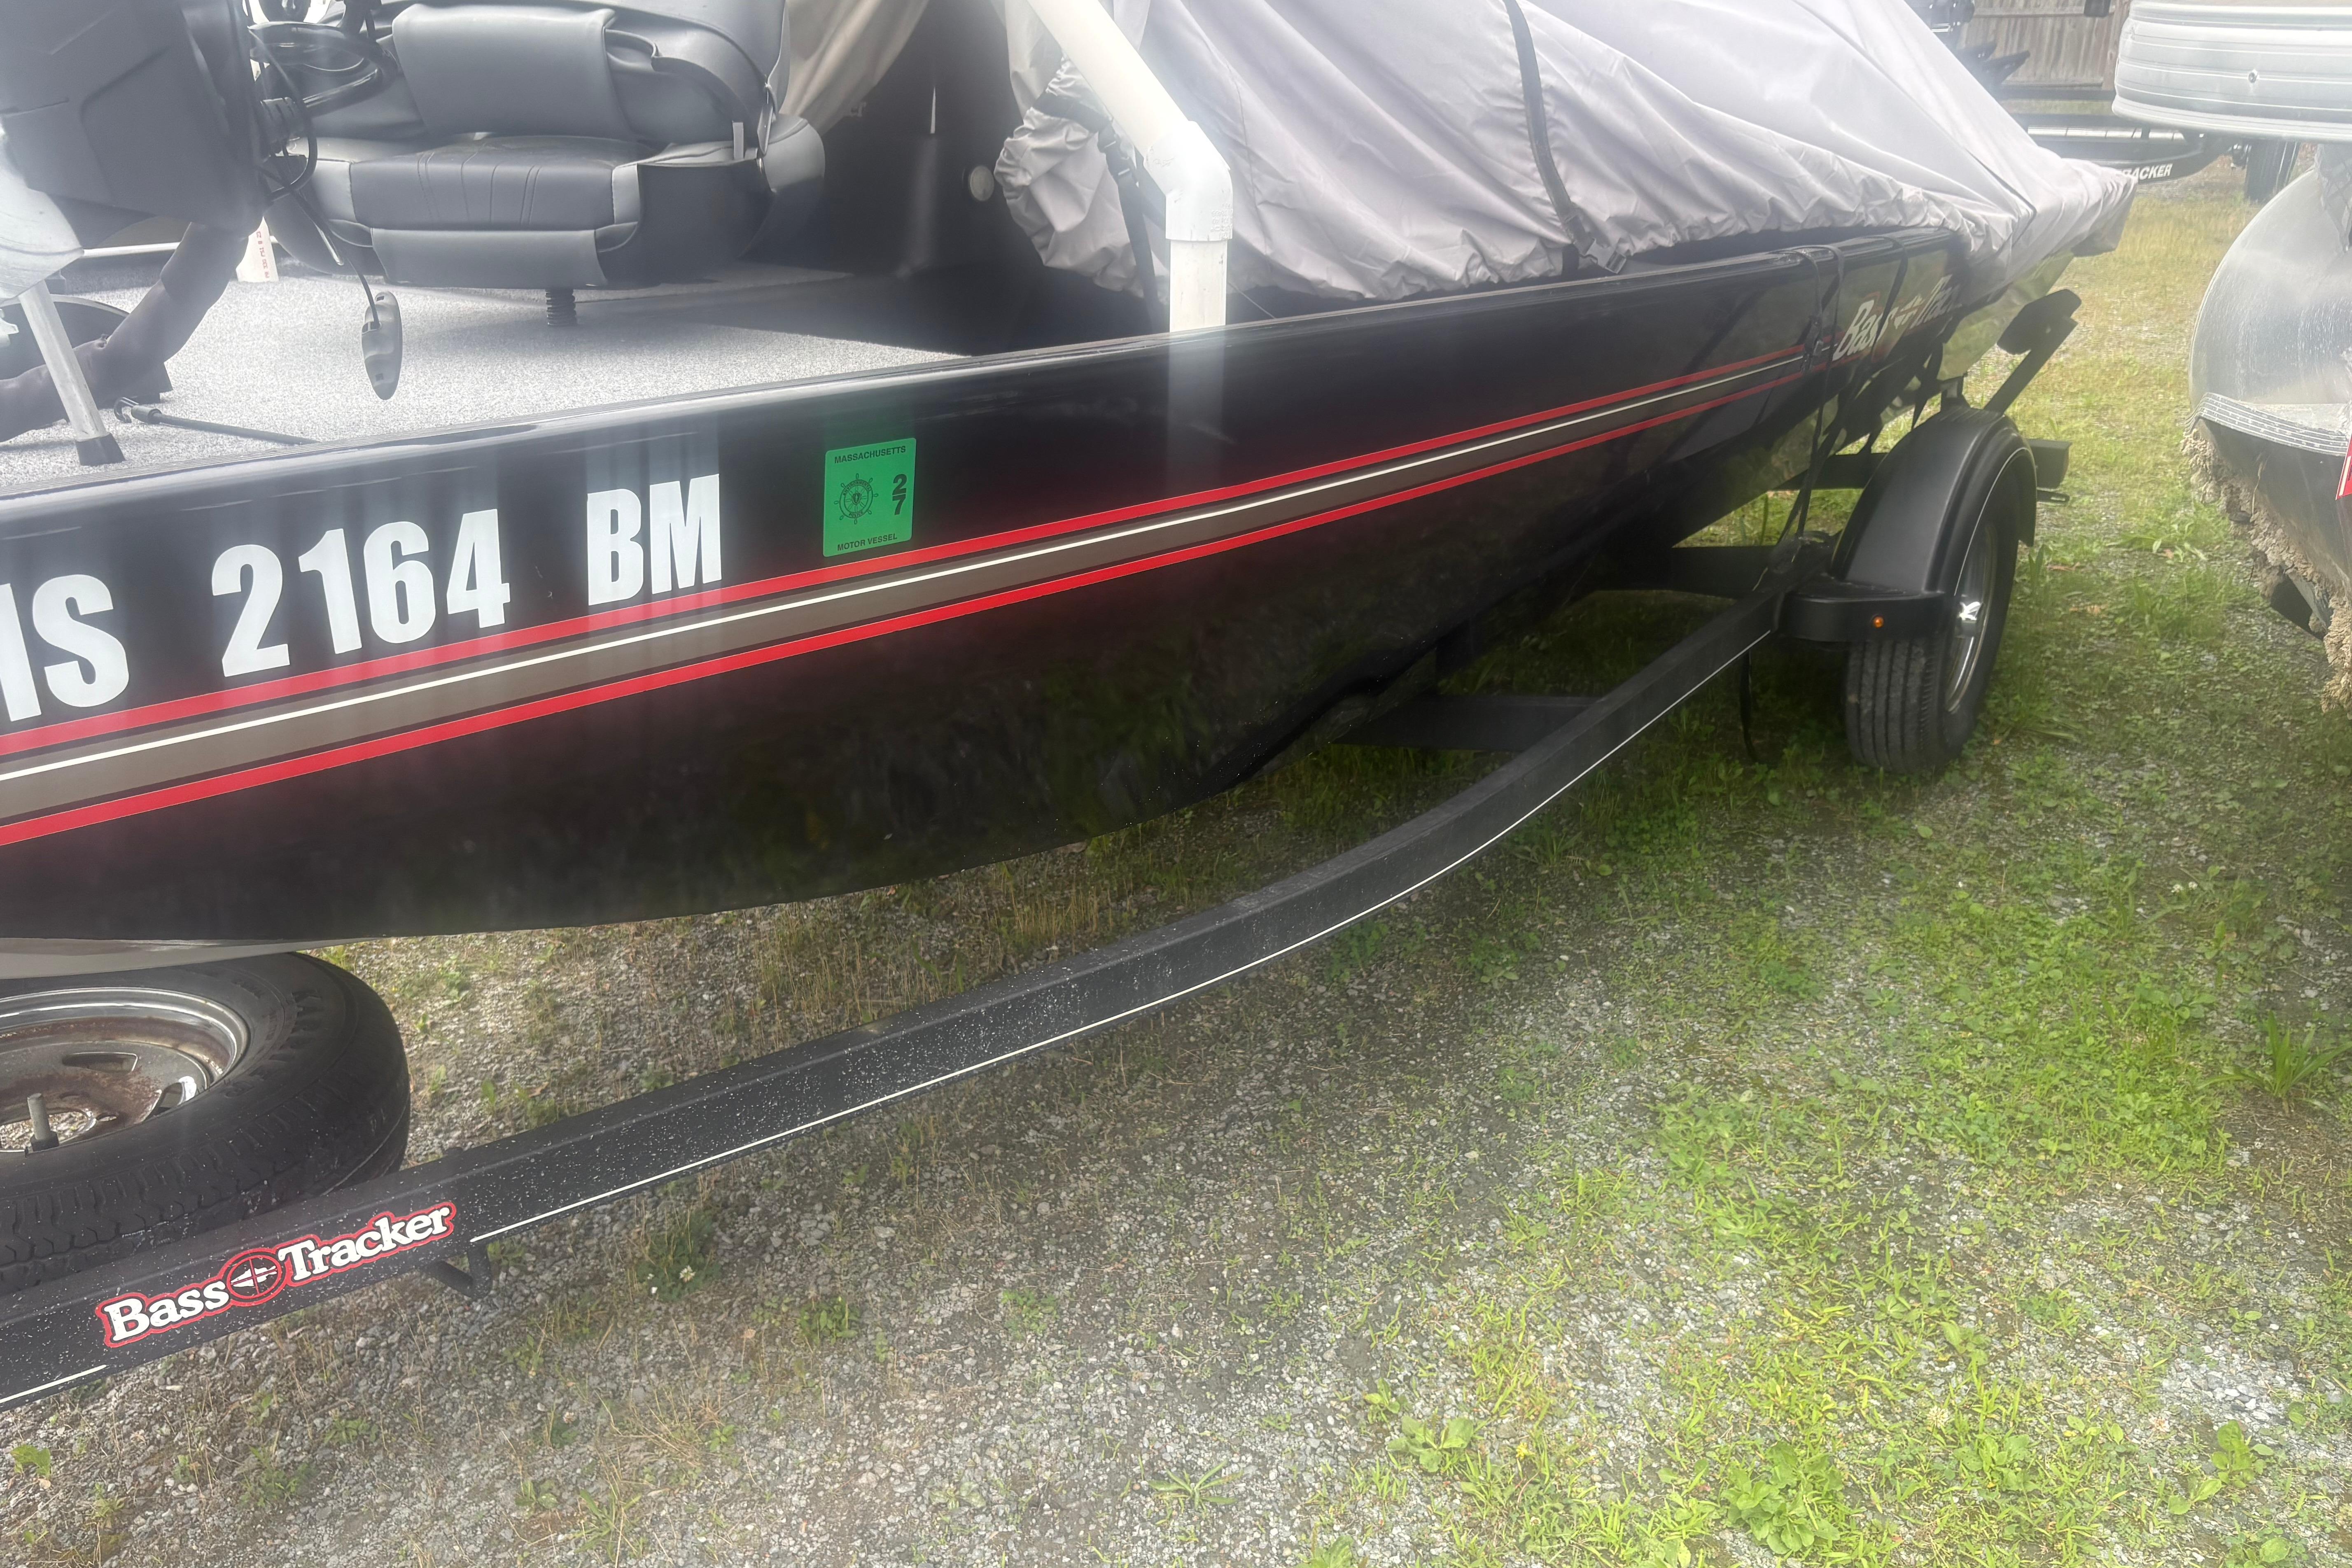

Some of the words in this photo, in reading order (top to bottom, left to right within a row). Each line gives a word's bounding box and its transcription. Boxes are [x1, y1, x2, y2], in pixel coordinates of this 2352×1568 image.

[834, 446, 906, 464] MASSACHUSETTS
[212, 509, 511, 677] 2164
[587, 474, 722, 605] BM
[837, 539, 866, 551] MOTOR
[868, 533, 898, 545] VESSEL
[104, 1281, 230, 1342] Bass
[278, 1207, 450, 1281] Tracker
